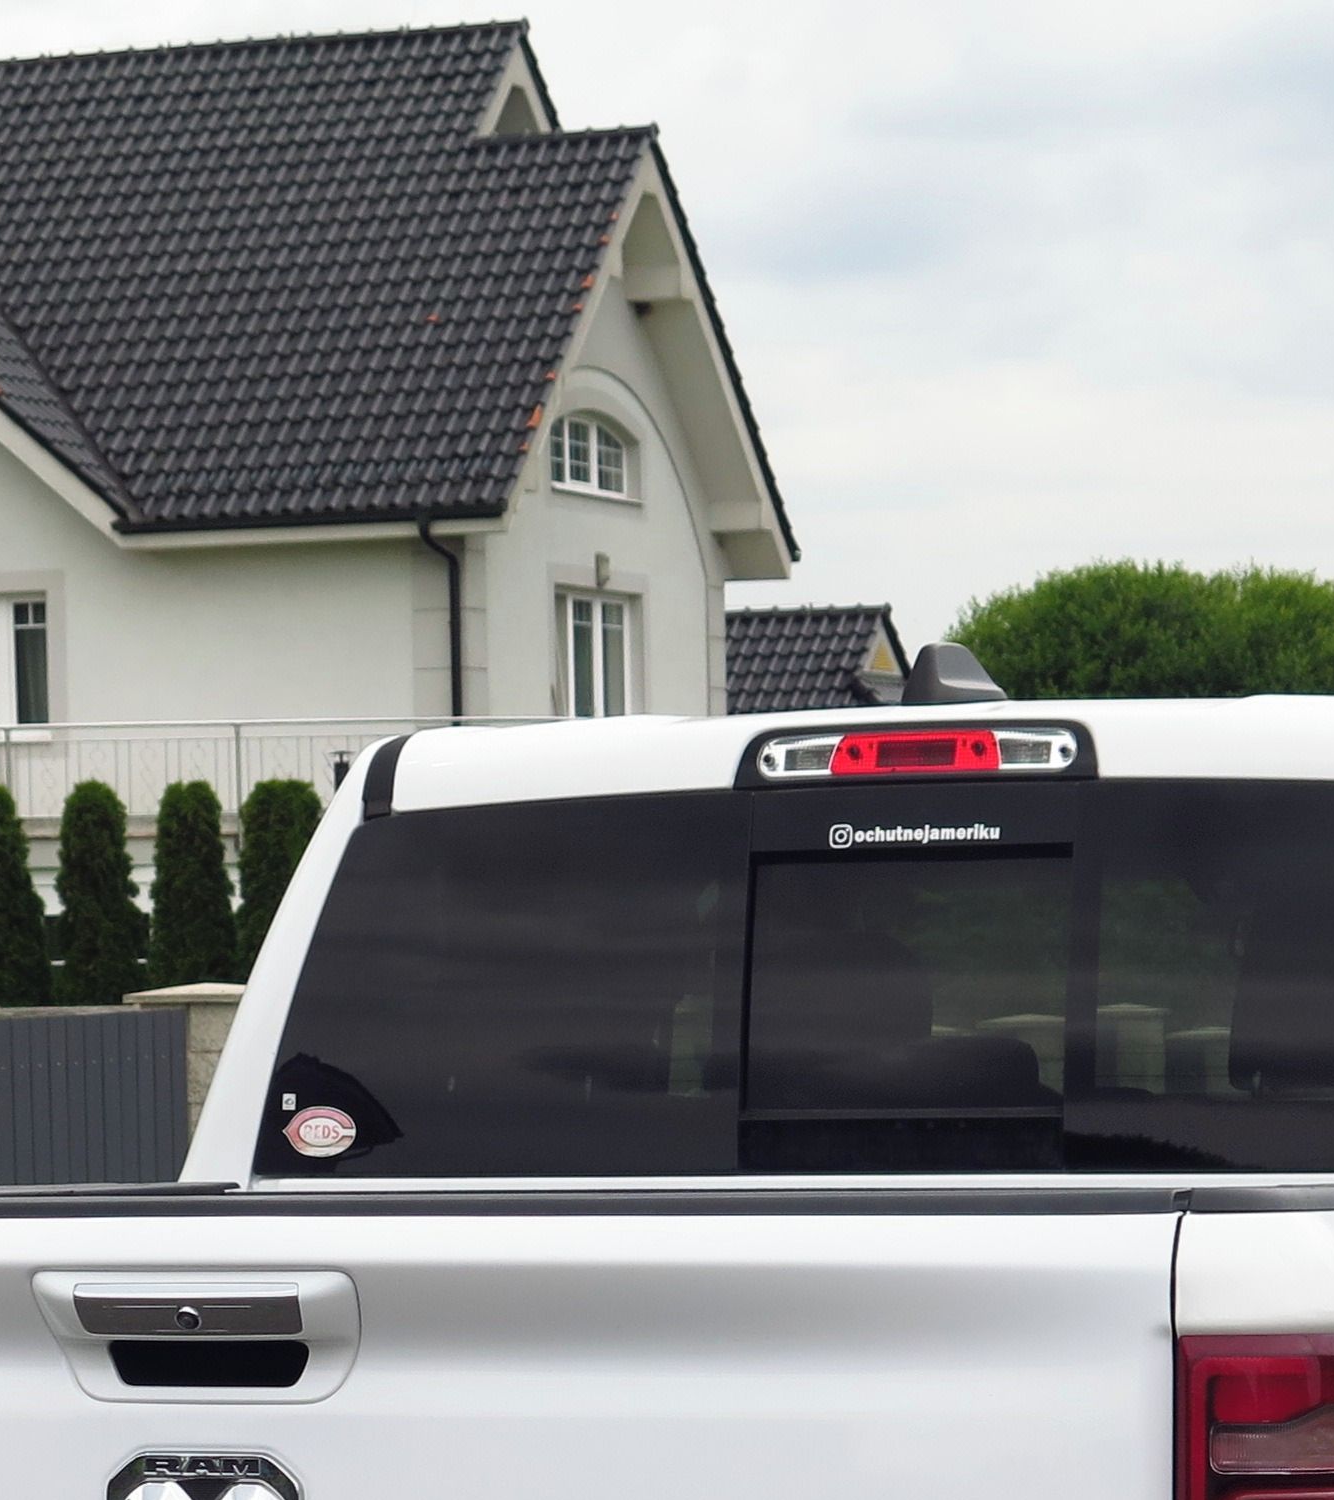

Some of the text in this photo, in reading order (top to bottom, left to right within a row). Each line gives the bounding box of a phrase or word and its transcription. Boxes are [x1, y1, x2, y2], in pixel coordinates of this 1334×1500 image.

[854, 824, 1001, 844] ochutnejameriku
[302, 1124, 341, 1141] REDS
[143, 1456, 261, 1476] RAM
